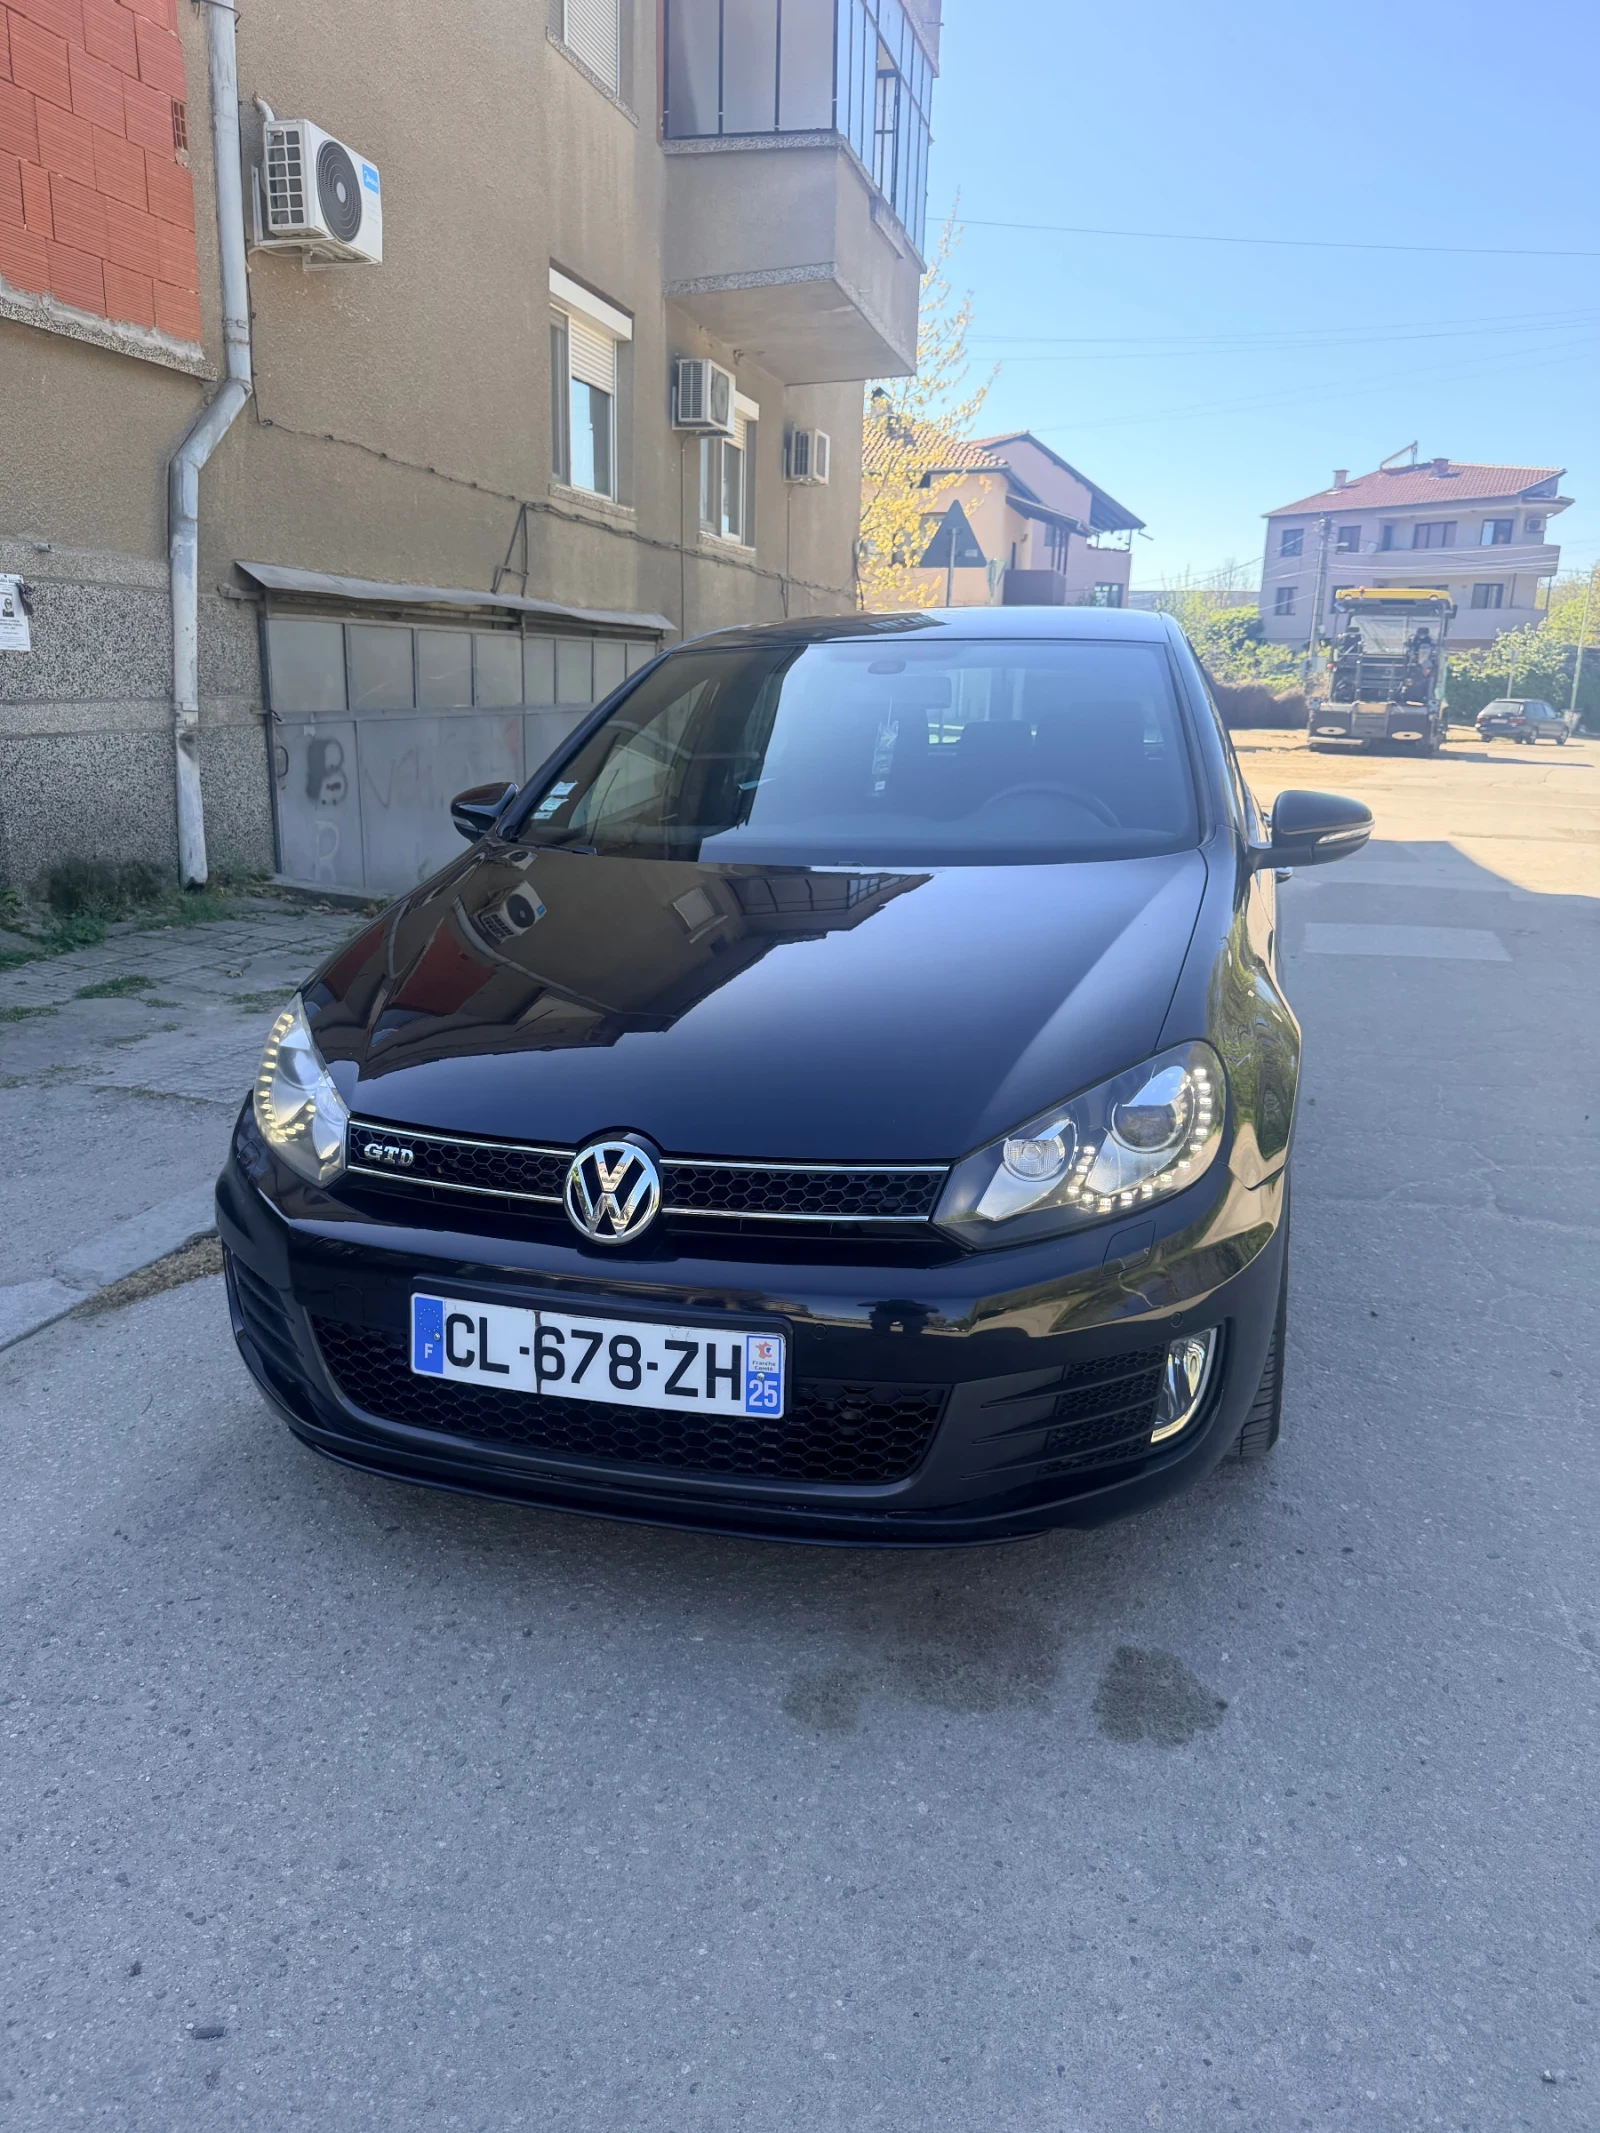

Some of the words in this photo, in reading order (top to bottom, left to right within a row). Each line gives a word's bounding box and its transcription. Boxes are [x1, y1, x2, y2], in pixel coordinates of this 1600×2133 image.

[364, 1143, 414, 1167] GTD
[424, 1342, 434, 1359] F
[445, 1312, 742, 1401] CL-678-ZH
[748, 1379, 778, 1408] 25
